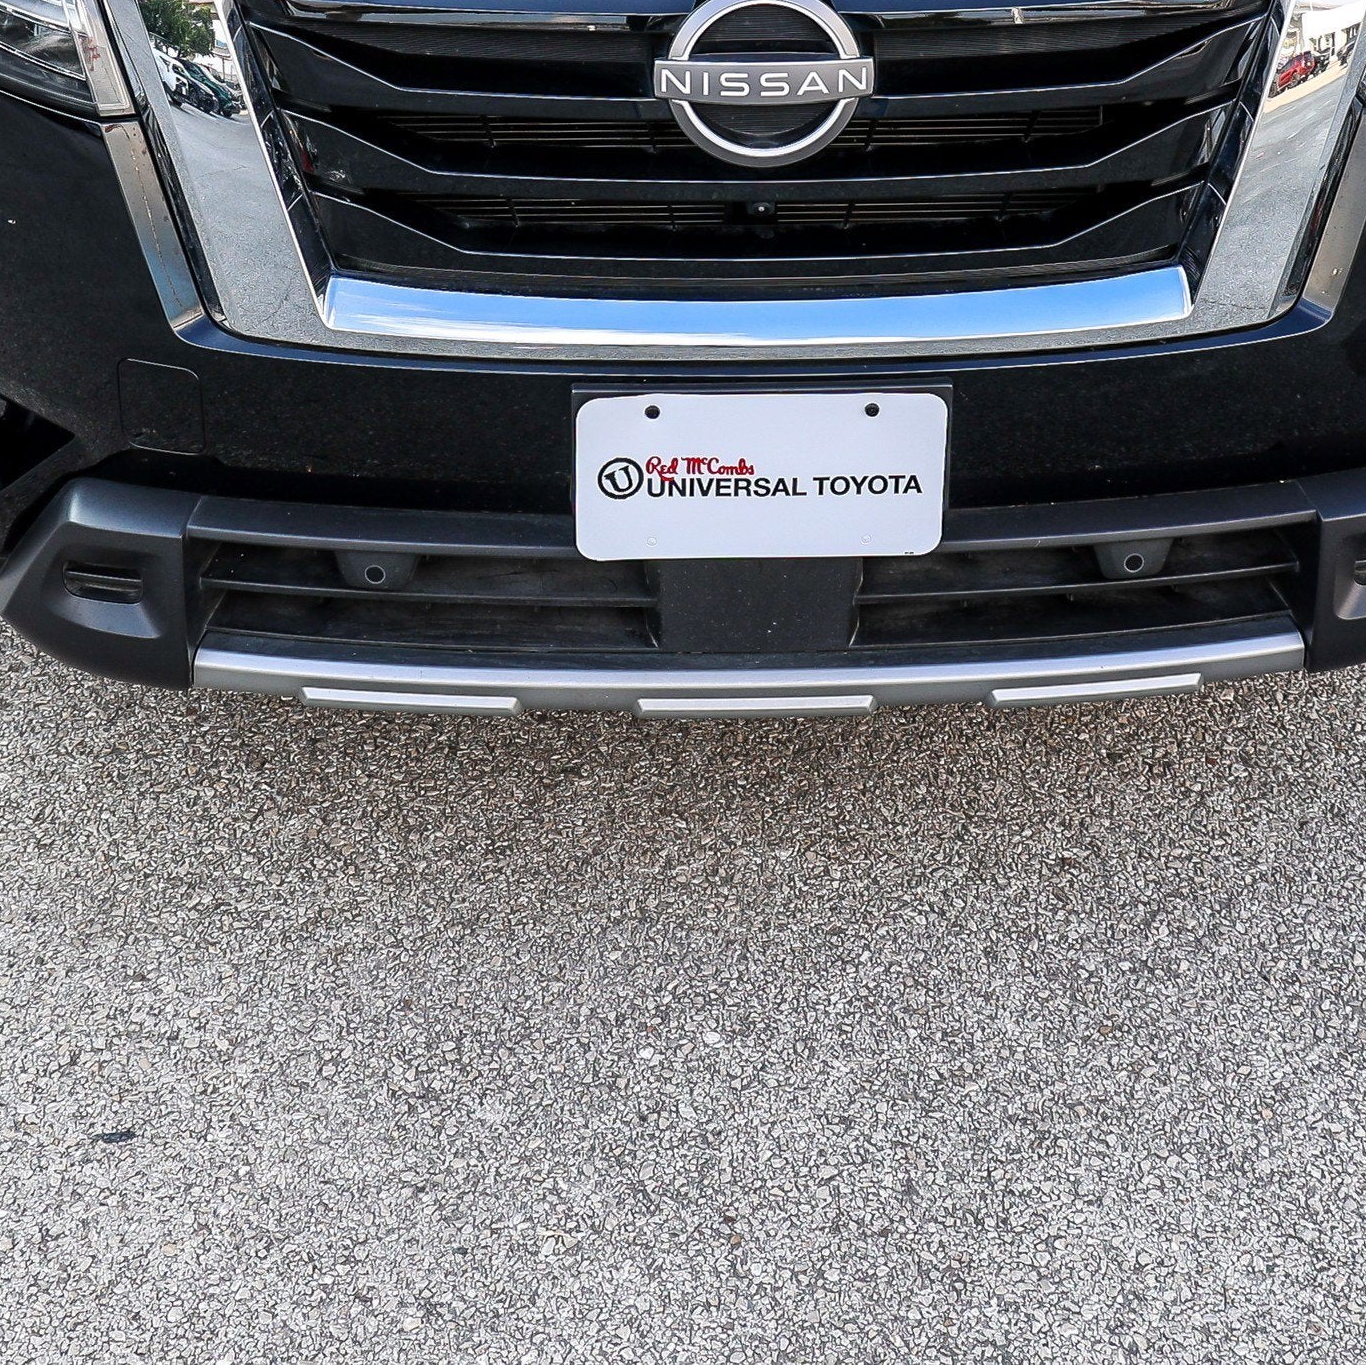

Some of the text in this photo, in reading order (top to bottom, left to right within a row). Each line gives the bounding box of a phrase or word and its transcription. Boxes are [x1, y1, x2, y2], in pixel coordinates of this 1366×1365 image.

[660, 66, 867, 97] NISSAN
[645, 456, 755, 481] Red McCombs
[647, 475, 923, 498] UNIVERSAL TOYOTA
